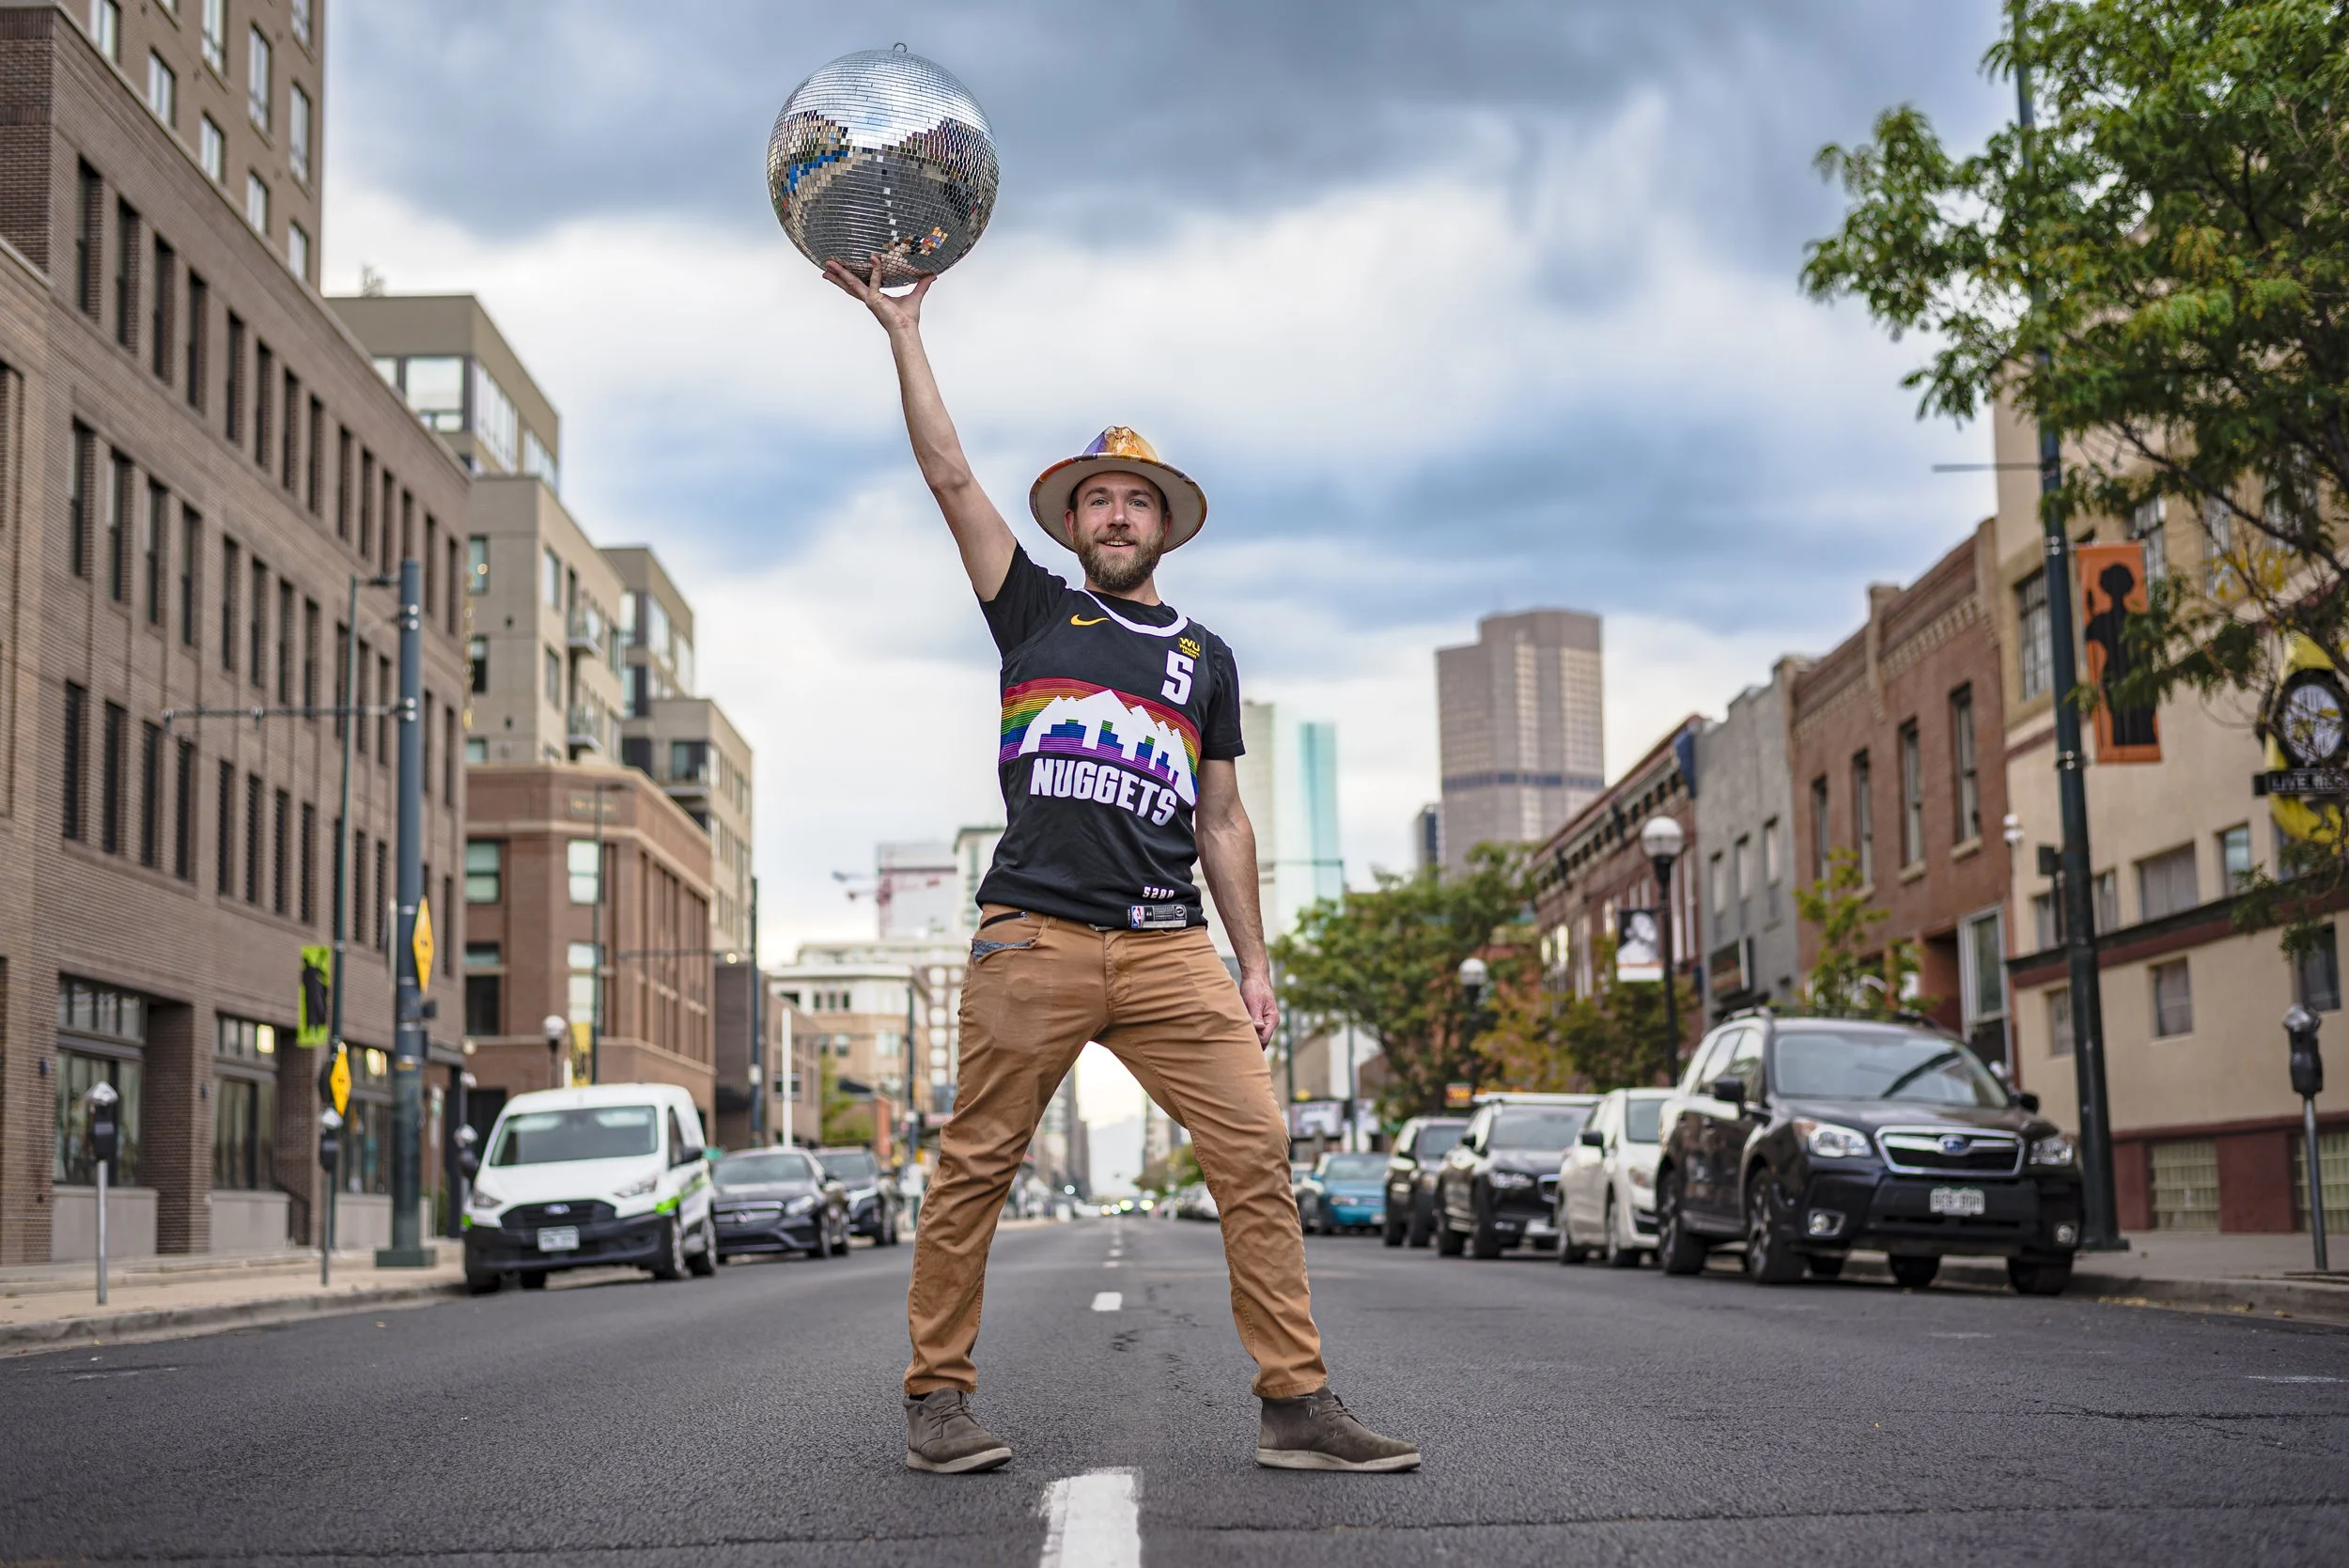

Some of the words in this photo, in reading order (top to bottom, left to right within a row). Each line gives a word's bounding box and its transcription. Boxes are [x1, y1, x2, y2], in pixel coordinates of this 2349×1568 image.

[1179, 637, 1201, 651] WU
[1179, 644, 1200, 657] Western
[1182, 648, 1197, 659] Union
[1160, 650, 1194, 705] 5
[1030, 757, 1177, 827] NUGGETS
[1142, 886, 1174, 900] 5280
